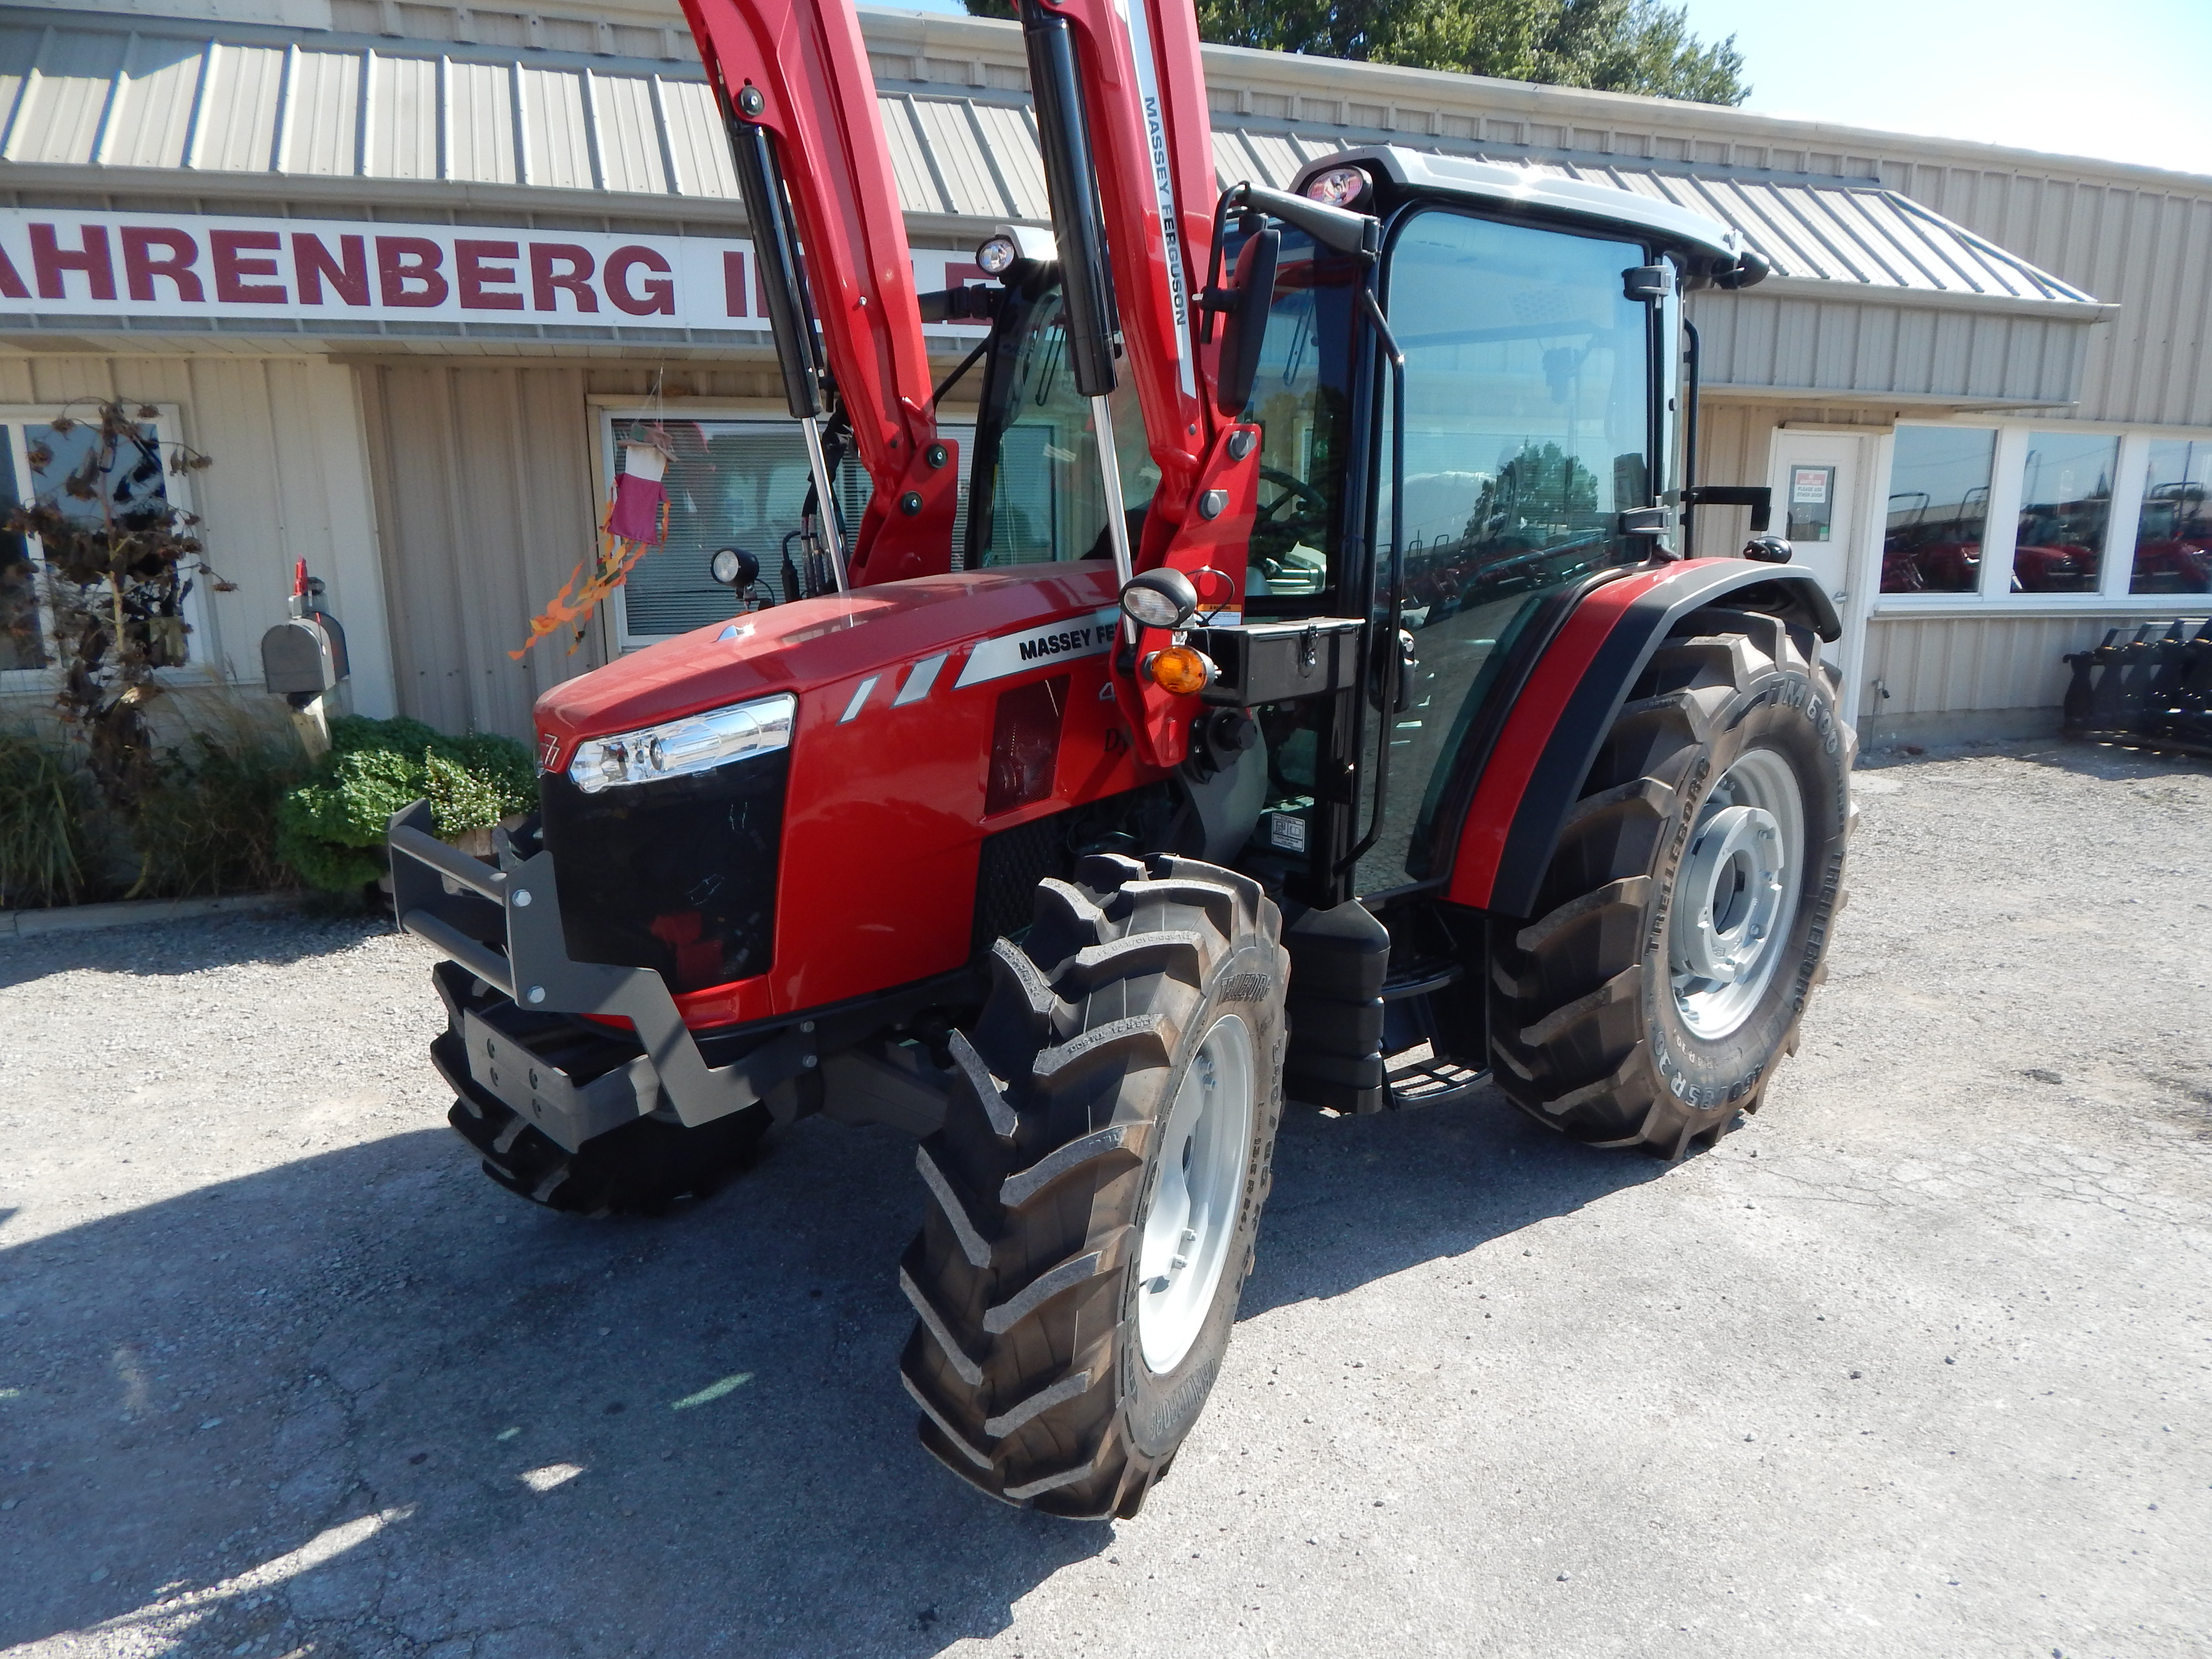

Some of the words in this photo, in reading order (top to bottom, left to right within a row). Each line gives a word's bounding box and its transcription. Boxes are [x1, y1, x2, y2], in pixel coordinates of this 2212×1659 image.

[1145, 96, 1170, 195] MASSEY
[1162, 204, 1186, 326] FERGUSON
[1019, 628, 1090, 661] MASSEY
[1096, 624, 1118, 644] FE
[1645, 756, 1710, 956] TRELLEBORG
